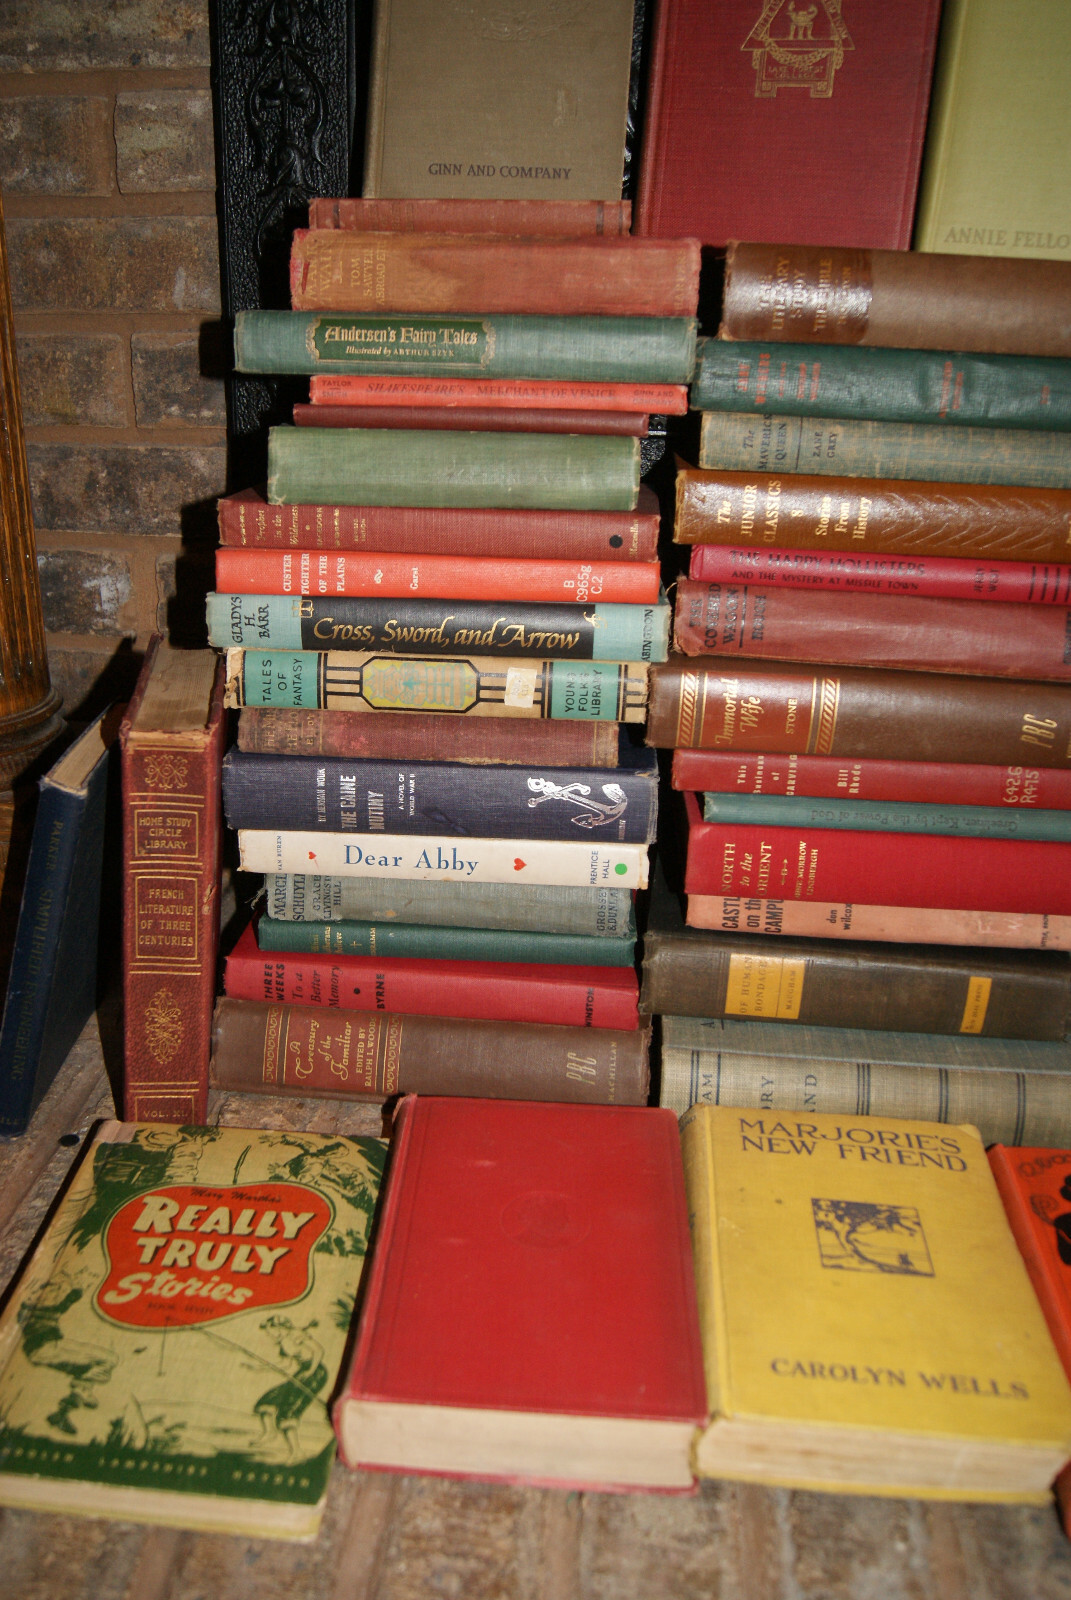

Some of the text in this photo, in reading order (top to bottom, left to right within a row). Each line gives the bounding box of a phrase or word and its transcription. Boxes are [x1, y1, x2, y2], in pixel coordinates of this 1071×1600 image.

[428, 162, 571, 179] GINN AND COMPANY
[944, 227, 1007, 246] ANNIE
[350, 256, 361, 288] TOM
[324, 326, 478, 347] Andersen's Fairy Tales
[345, 345, 382, 355] Illustrated
[384, 347, 392, 357] by
[366, 382, 617, 399] SHAKESPEARE'S MERCHANT OF VENICE
[743, 430, 755, 449] The
[774, 423, 787, 461] QUEEN
[813, 431, 823, 458] ZANE
[827, 432, 838, 458] GREY
[289, 505, 299, 545] Wilderness
[717, 501, 732, 525] The
[741, 484, 758, 537] JUNIOR
[764, 480, 782, 543] CLASSICS
[791, 510, 803, 518] 8
[815, 496, 832, 536] Stories
[834, 502, 851, 533] From
[853, 496, 872, 540] History
[283, 554, 292, 592] CUSTER
[301, 553, 310, 595] FIGHTER
[319, 555, 328, 593] OF THE
[336, 557, 345, 592] PLAINS
[410, 567, 419, 590] Garst
[730, 550, 926, 577] THE HAPPY HOLLISTERS
[732, 571, 754, 580] AND
[759, 571, 776, 581] THE
[782, 574, 824, 585] MYSTERY
[829, 577, 841, 585] AT
[845, 578, 883, 588] MISSILE
[563, 580, 575, 588] B
[591, 576, 603, 595] C.2
[231, 596, 243, 644] GLADYS
[245, 613, 256, 627] H.
[259, 603, 271, 639] BARR
[314, 615, 580, 650] Cross, Sword, and Arrow
[705, 583, 722, 648] COVERED
[723, 587, 740, 644] WAGON
[262, 659, 272, 702] TALES
[278, 672, 287, 691] OF
[293, 658, 303, 706] FANTASY
[565, 672, 576, 713] YOUNG
[578, 672, 588, 712] FOLKS
[591, 669, 603, 716] LIBRARY
[714, 678, 738, 745] Immortal
[739, 696, 765, 733] Wife
[785, 697, 799, 734] STONE
[398, 773, 405, 783] OF
[737, 765, 748, 784] This
[753, 756, 764, 794] Business
[771, 772, 780, 781] of
[786, 754, 798, 796] CARVING
[837, 769, 849, 788] Bill
[848, 764, 862, 794] Rhode
[1002, 766, 1023, 803] 642.6
[1020, 769, 1040, 803] R475
[316, 768, 327, 822] BY HERMAN WOUK
[340, 775, 357, 829] THE CAINE
[368, 790, 385, 830] MUTINY
[139, 817, 192, 827] HOME STUDY
[149, 829, 182, 838] CIRCLE
[145, 840, 188, 850] LIBRARY
[344, 845, 480, 876] Dear Abby
[796, 840, 807, 878] MORROW
[590, 850, 599, 885] PRENTICE
[602, 859, 610, 879] HALL
[720, 843, 736, 893] NORTH
[739, 853, 753, 887] to the
[755, 841, 772, 896] ORIENT
[806, 849, 819, 895] LINDBERGH
[139, 905, 194, 916] LITERATURE
[149, 889, 184, 900] FRENCH
[312, 875, 322, 911] GRACE
[333, 882, 342, 906] HILL
[141, 920, 191, 931] OF THREE
[746, 911, 761, 928] on
[826, 908, 838, 924] don
[139, 935, 194, 946] CENTURIES
[264, 963, 273, 999] THREE
[276, 963, 286, 1001] WEEKS
[291, 972, 304, 999] To a
[310, 970, 322, 1003] Better
[328, 965, 344, 1009] Memory
[376, 974, 386, 1009] BYRNE
[739, 956, 753, 1014] OF HUMAN
[754, 960, 768, 1012] BONDAGE
[785, 970, 796, 1010] MAUGHAM
[585, 987, 595, 1027] WINSTON
[289, 1040, 301, 1055] A
[295, 1019, 320, 1079] Treasury
[318, 1035, 333, 1062] of the
[330, 1021, 353, 1081] Familiar
[356, 1027, 367, 1073] EDITED BY
[364, 1016, 378, 1087] RALPH WOODS
[608, 1041, 617, 1101] MACMILLAN
[739, 1118, 962, 1155] MARJORIE'S
[741, 1136, 968, 1173] NEW FRIEND
[132, 1195, 316, 1240] REALLY
[136, 1236, 291, 1275] TRULY
[103, 1270, 253, 1305] Stories
[771, 1357, 1030, 1400] CAROLYN WELLS
